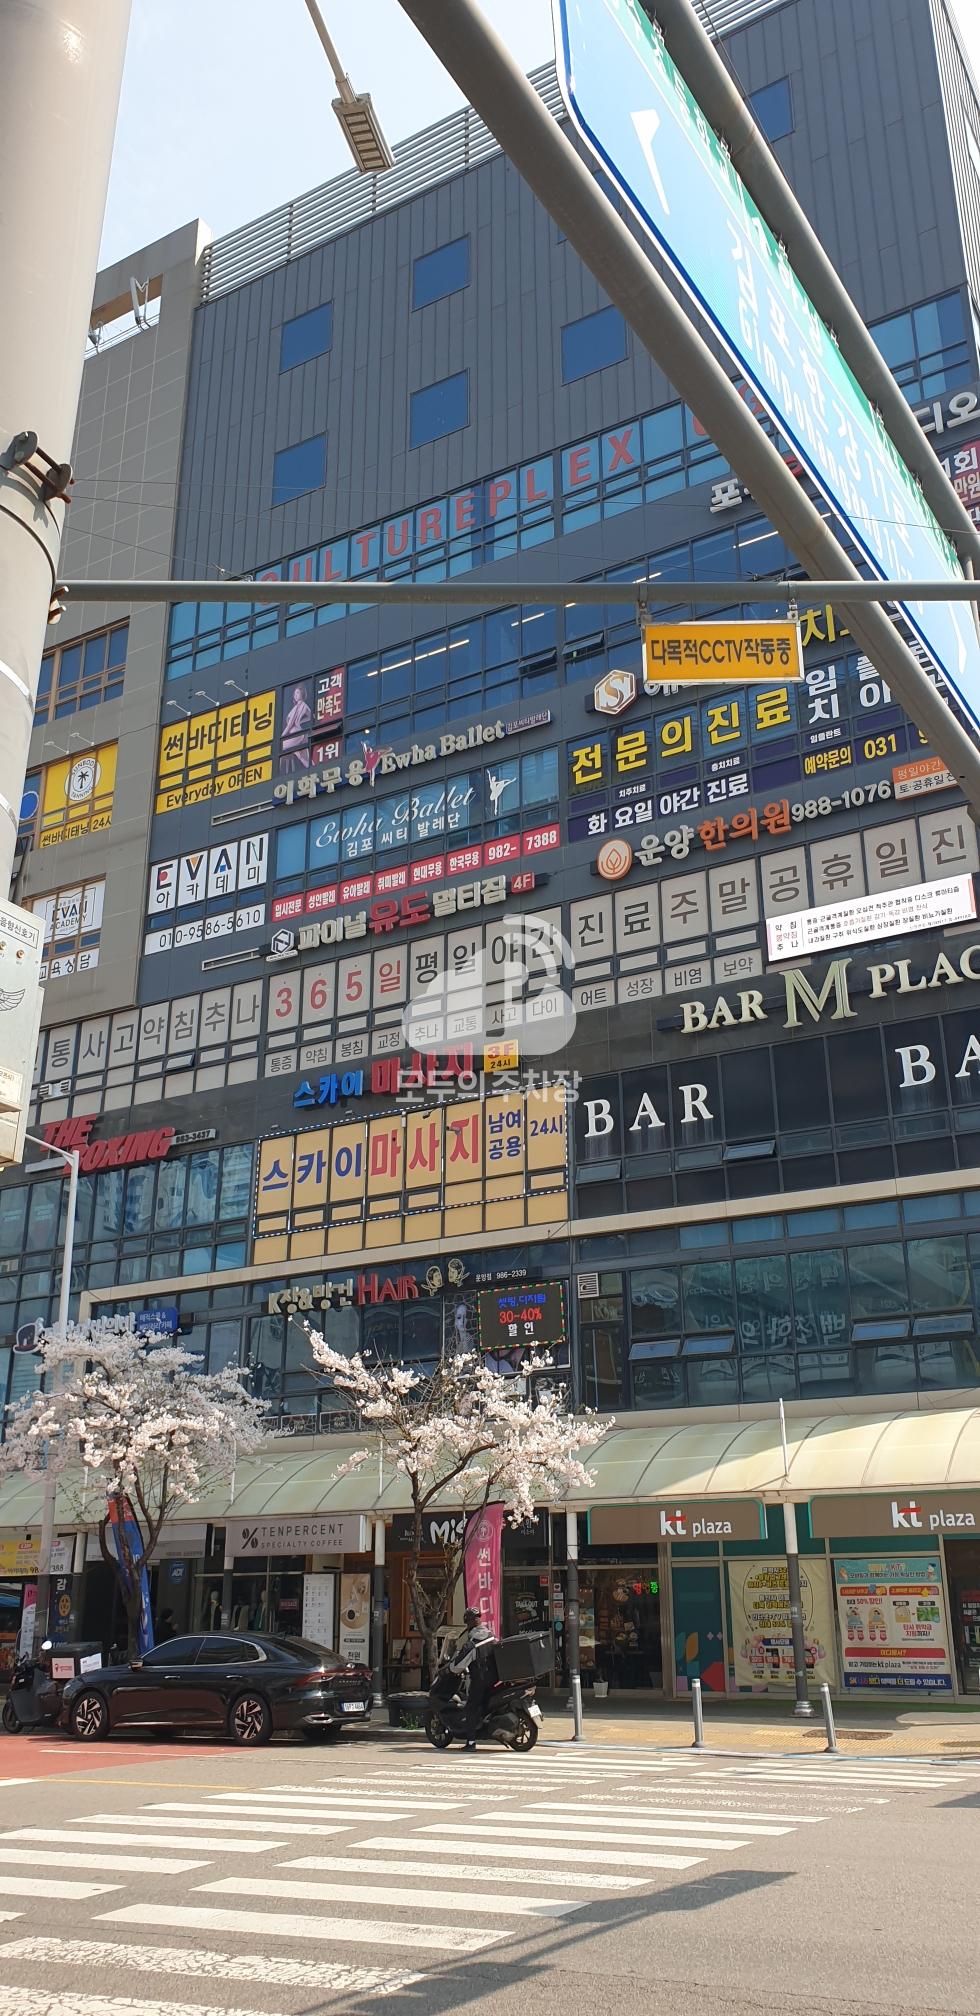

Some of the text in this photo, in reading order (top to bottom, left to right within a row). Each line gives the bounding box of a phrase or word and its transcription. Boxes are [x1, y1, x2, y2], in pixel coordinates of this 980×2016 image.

[651, 638, 792, 666] 다목적CCTV작동중
[317, 672, 342, 694] 고객
[317, 692, 342, 720] 만족도
[164, 702, 273, 761] 썬바디태닝
[273, 719, 506, 806] 이화무용 Ewha Ballet
[316, 741, 340, 763] 1위
[804, 745, 853, 775] 예약문의
[864, 733, 897, 760] 031
[166, 765, 263, 809] Everyday OPEN
[660, 786, 700, 815] 야간
[707, 772, 749, 804] 진료
[791, 780, 892, 823] 988-1076
[394, 783, 479, 827] Ballet
[417, 811, 461, 837] 발레단
[308, 887, 336, 909] 성인발레
[342, 878, 371, 901] 유아발레
[377, 869, 406, 891] 취미발레
[413, 860, 443, 882] 현대무용
[449, 851, 480, 872] 한국무용
[488, 842, 518, 861] 982-
[526, 830, 557, 851] 7388
[513, 876, 534, 893] 4F
[156, 865, 261, 909] 아카데미
[159, 911, 261, 948] 010-9586-5610
[680, 990, 769, 1034] BAR
[778, 957, 858, 1028] M
[270, 1055, 293, 1073] 통증
[305, 1047, 328, 1064] 약침
[341, 1038, 364, 1057] 봉침
[377, 1032, 401, 1050] 교정
[414, 1023, 438, 1041] 추나
[453, 1014, 477, 1033] 교통
[580, 986, 606, 1006] 어트
[626, 977, 654, 997] 성장
[674, 967, 702, 987] 비염
[723, 955, 752, 976] 보약
[490, 1059, 511, 1070] 24시
[488, 1108, 522, 1134] 남여
[530, 1113, 563, 1138] 24시
[583, 1083, 714, 1138] BAR
[40, 1113, 97, 1152] THE
[488, 1136, 522, 1162] 공용
[357, 1272, 420, 1305] HAIR
[499, 1307, 543, 1324] 30-40%
[260, 1522, 345, 1538] TENPERCENT
[659, 1509, 732, 1538] kt plaza
[891, 1501, 976, 1531] kt plaza
[260, 1538, 344, 1549] SPECIALTY COFFEE
